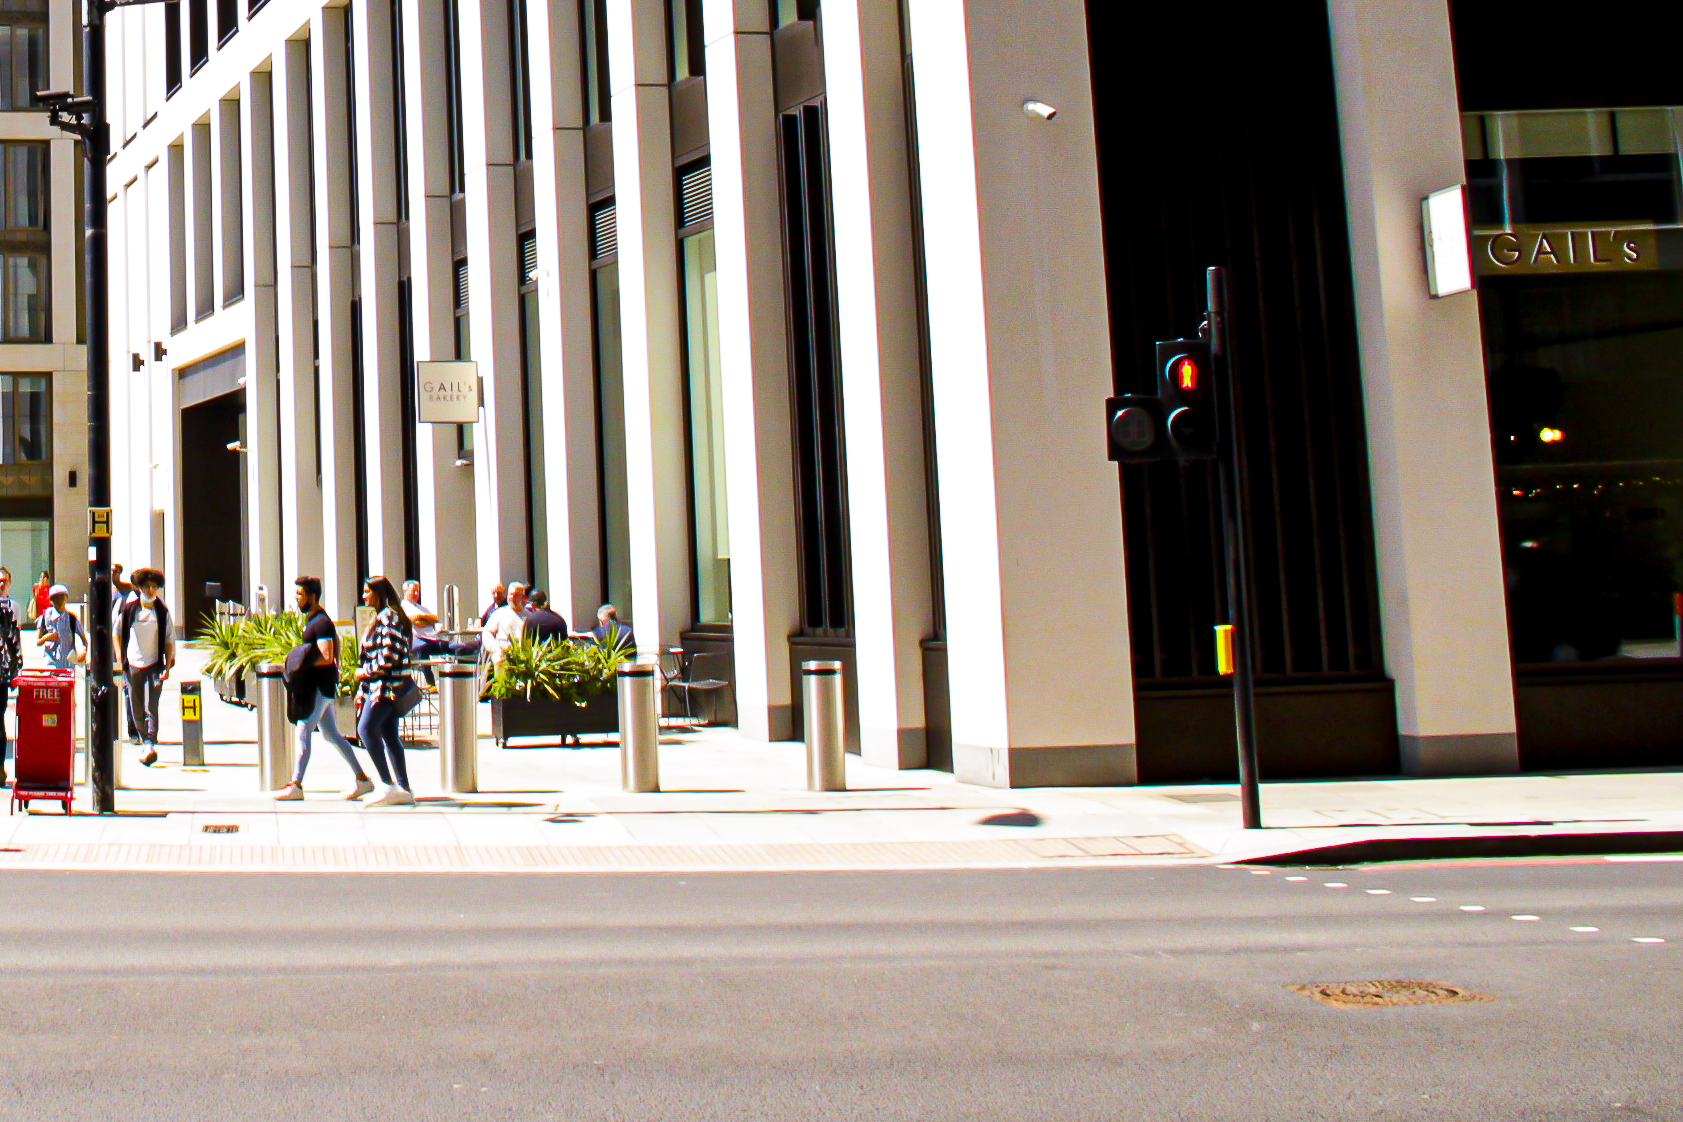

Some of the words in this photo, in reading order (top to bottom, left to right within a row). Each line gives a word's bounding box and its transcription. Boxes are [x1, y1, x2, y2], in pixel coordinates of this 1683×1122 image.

[1488, 230, 1641, 268] GAIL's
[429, 394, 467, 402] BAKERY
[92, 512, 109, 534] H
[33, 688, 61, 699] FREE
[182, 698, 196, 716] H
